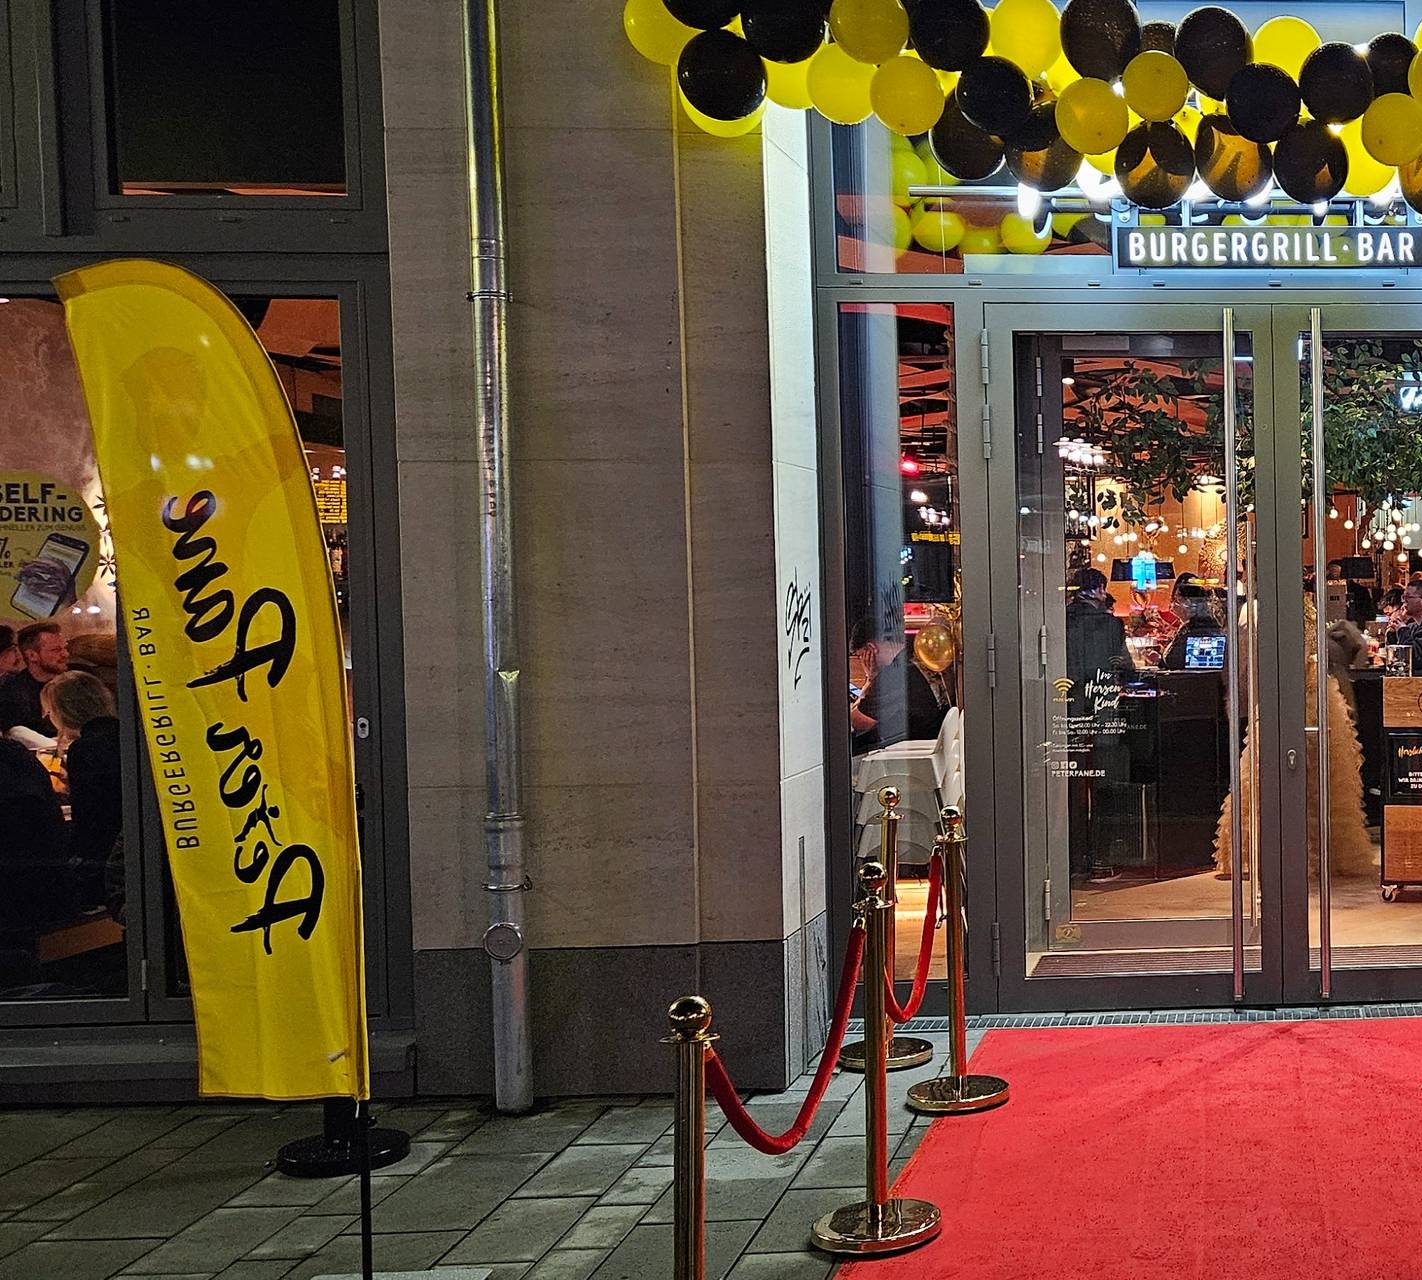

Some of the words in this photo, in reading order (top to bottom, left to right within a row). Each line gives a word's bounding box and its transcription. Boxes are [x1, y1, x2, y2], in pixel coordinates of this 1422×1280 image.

[1128, 232, 1337, 263] BURGERGRILL
[1357, 232, 1415, 263] BAR
[0, 483, 67, 504] ELF-
